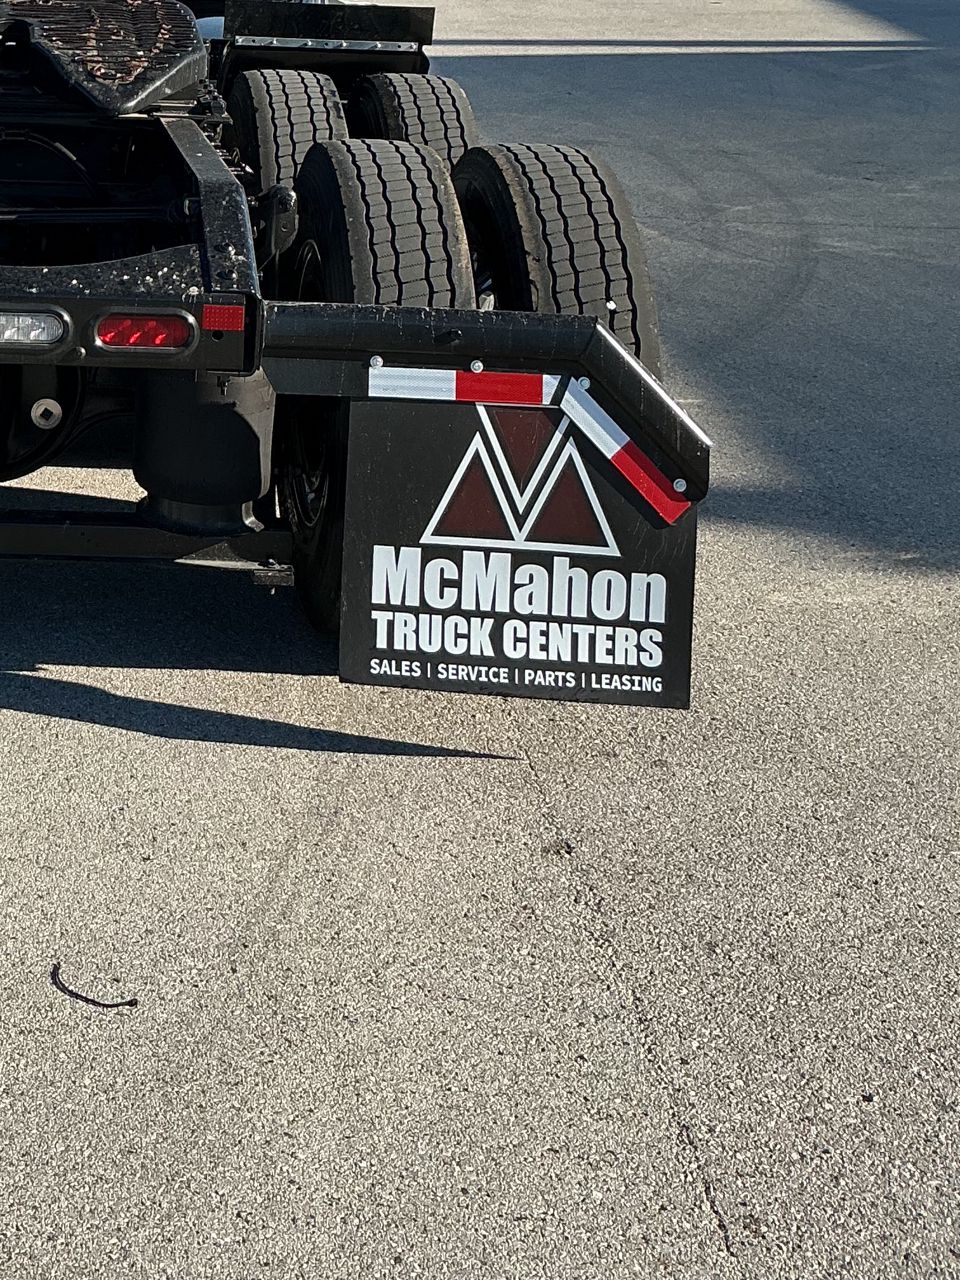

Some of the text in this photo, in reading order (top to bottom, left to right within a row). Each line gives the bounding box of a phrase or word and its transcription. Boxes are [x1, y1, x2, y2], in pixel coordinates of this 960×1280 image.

[371, 545, 667, 623] McMahon
[371, 610, 663, 667] TRUCK CENTERS
[370, 658, 662, 692] SALES SERVICE PARTS LEASING
